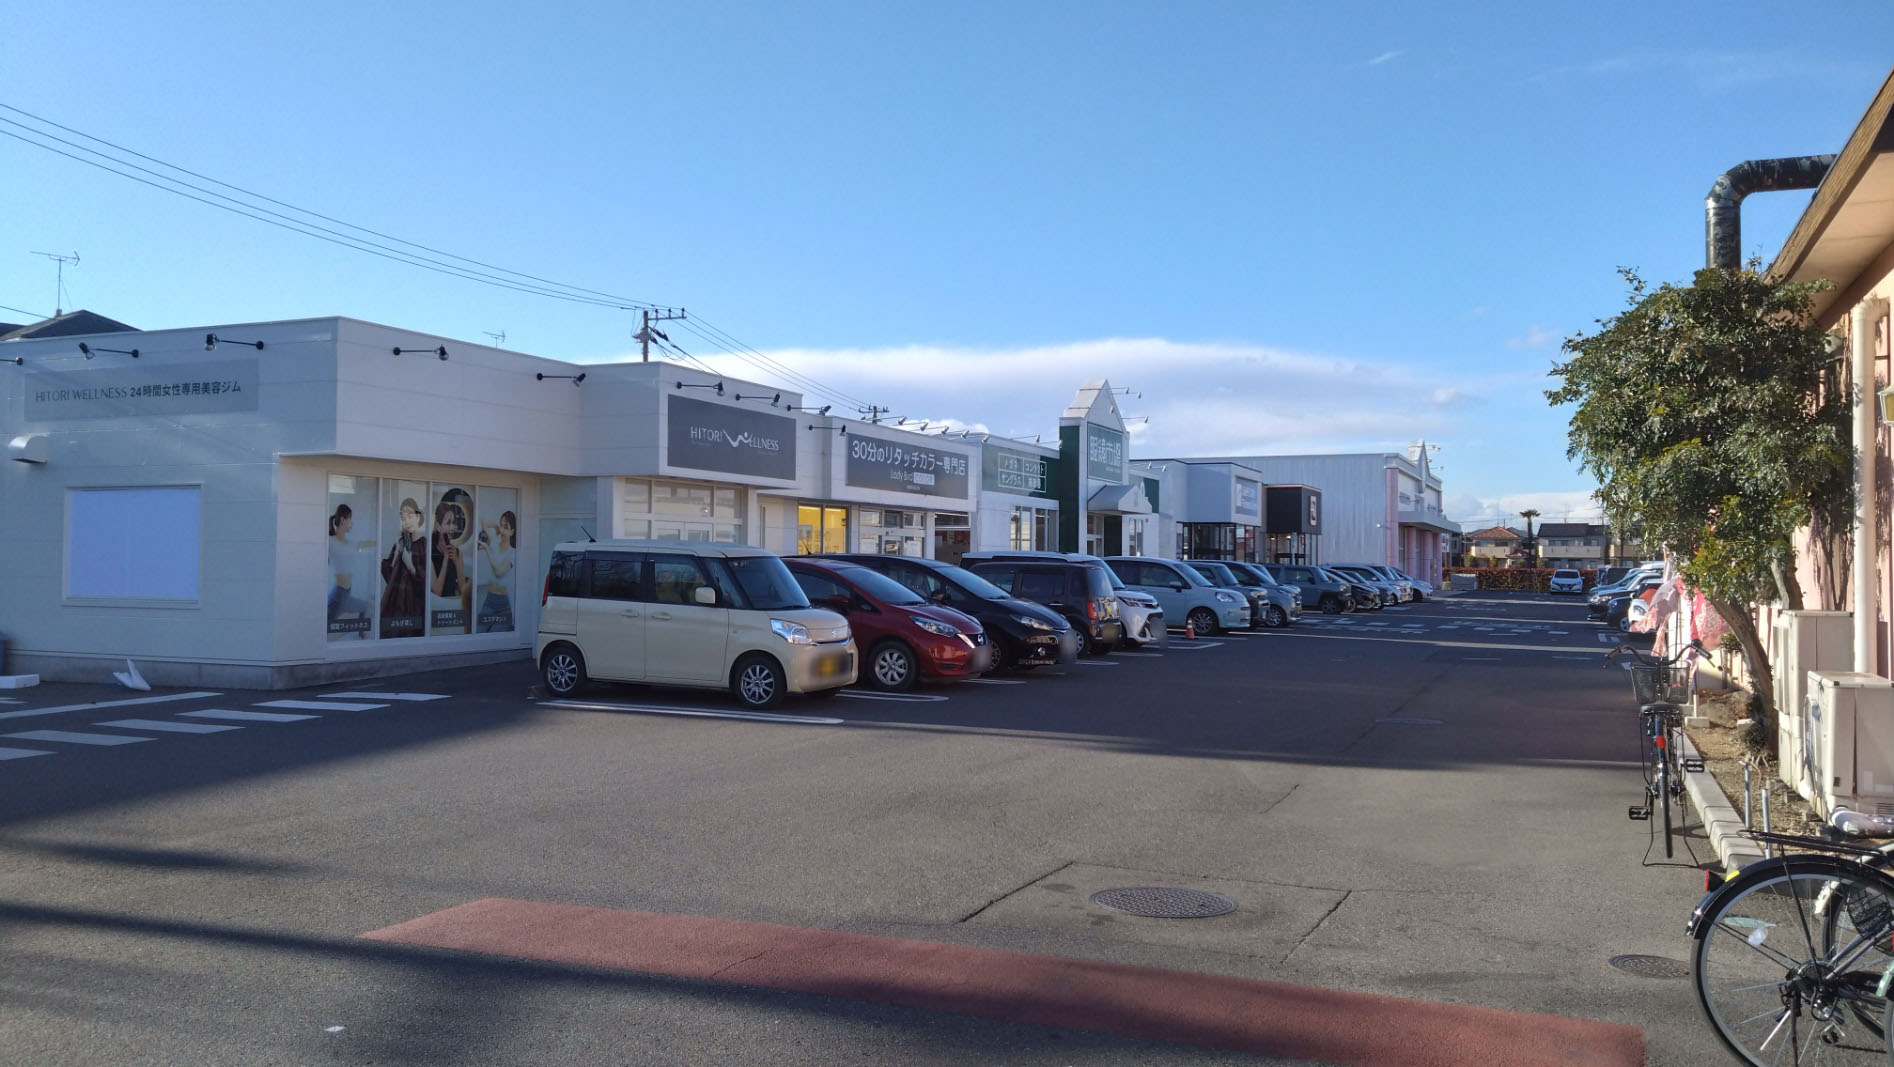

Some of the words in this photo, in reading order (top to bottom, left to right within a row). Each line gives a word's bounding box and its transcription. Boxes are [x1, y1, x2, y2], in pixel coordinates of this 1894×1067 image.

[35, 390, 70, 402] HITORI
[72, 387, 128, 401] WELLNESS
[130, 380, 242, 397] 24時間女性専用美容ジム
[690, 426, 723, 442] HITORI
[723, 429, 780, 451] WELLNESS
[852, 440, 966, 476] 30分のリタッチカラー専門店
